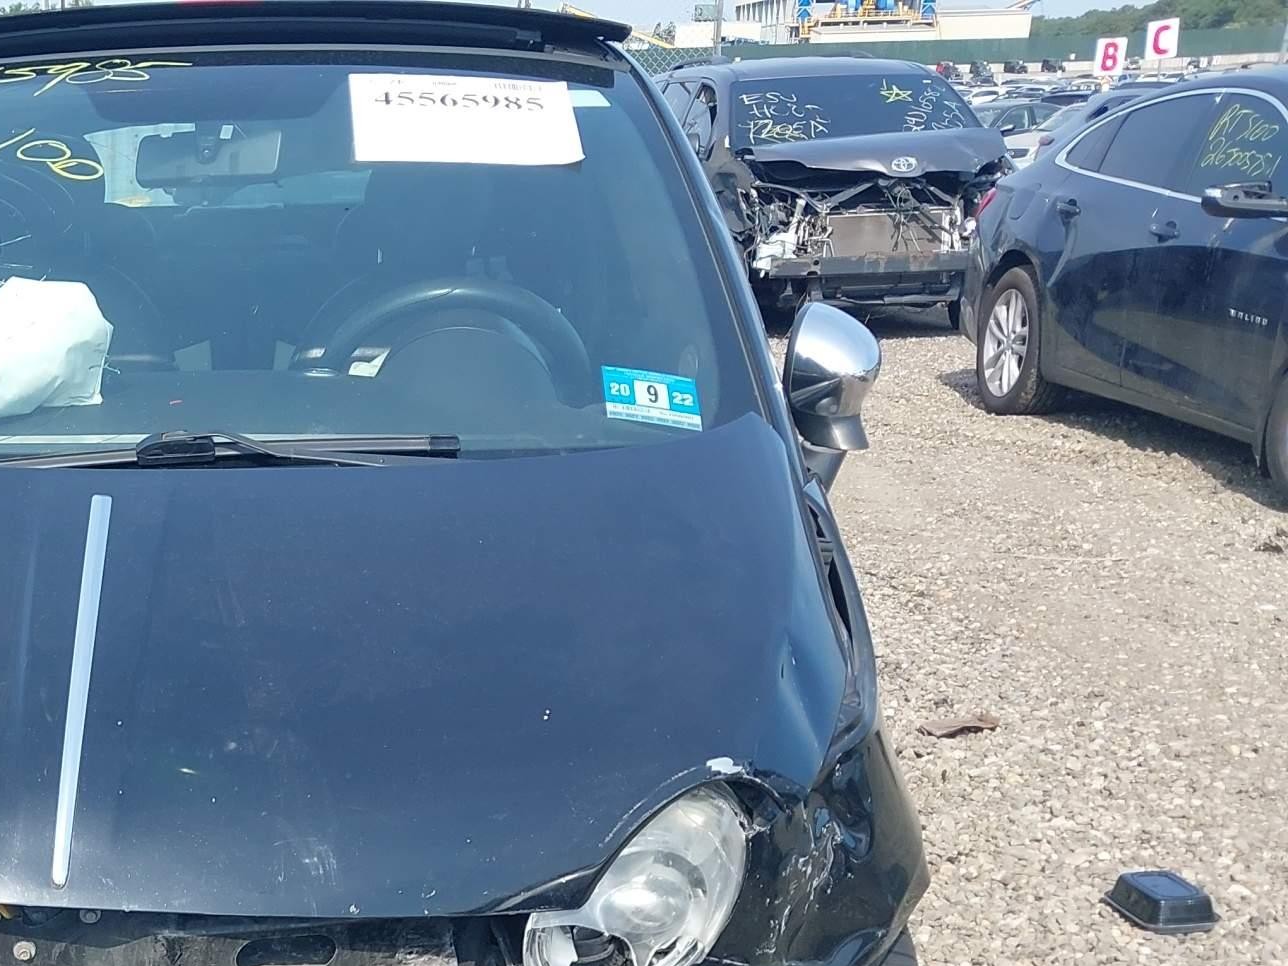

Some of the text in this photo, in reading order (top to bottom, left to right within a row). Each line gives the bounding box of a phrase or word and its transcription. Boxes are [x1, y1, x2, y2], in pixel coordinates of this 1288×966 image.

[1152, 25, 1171, 55] C
[1100, 42, 1119, 71] B
[374, 91, 545, 112] 45565985
[609, 382, 695, 406] 20 9 22
